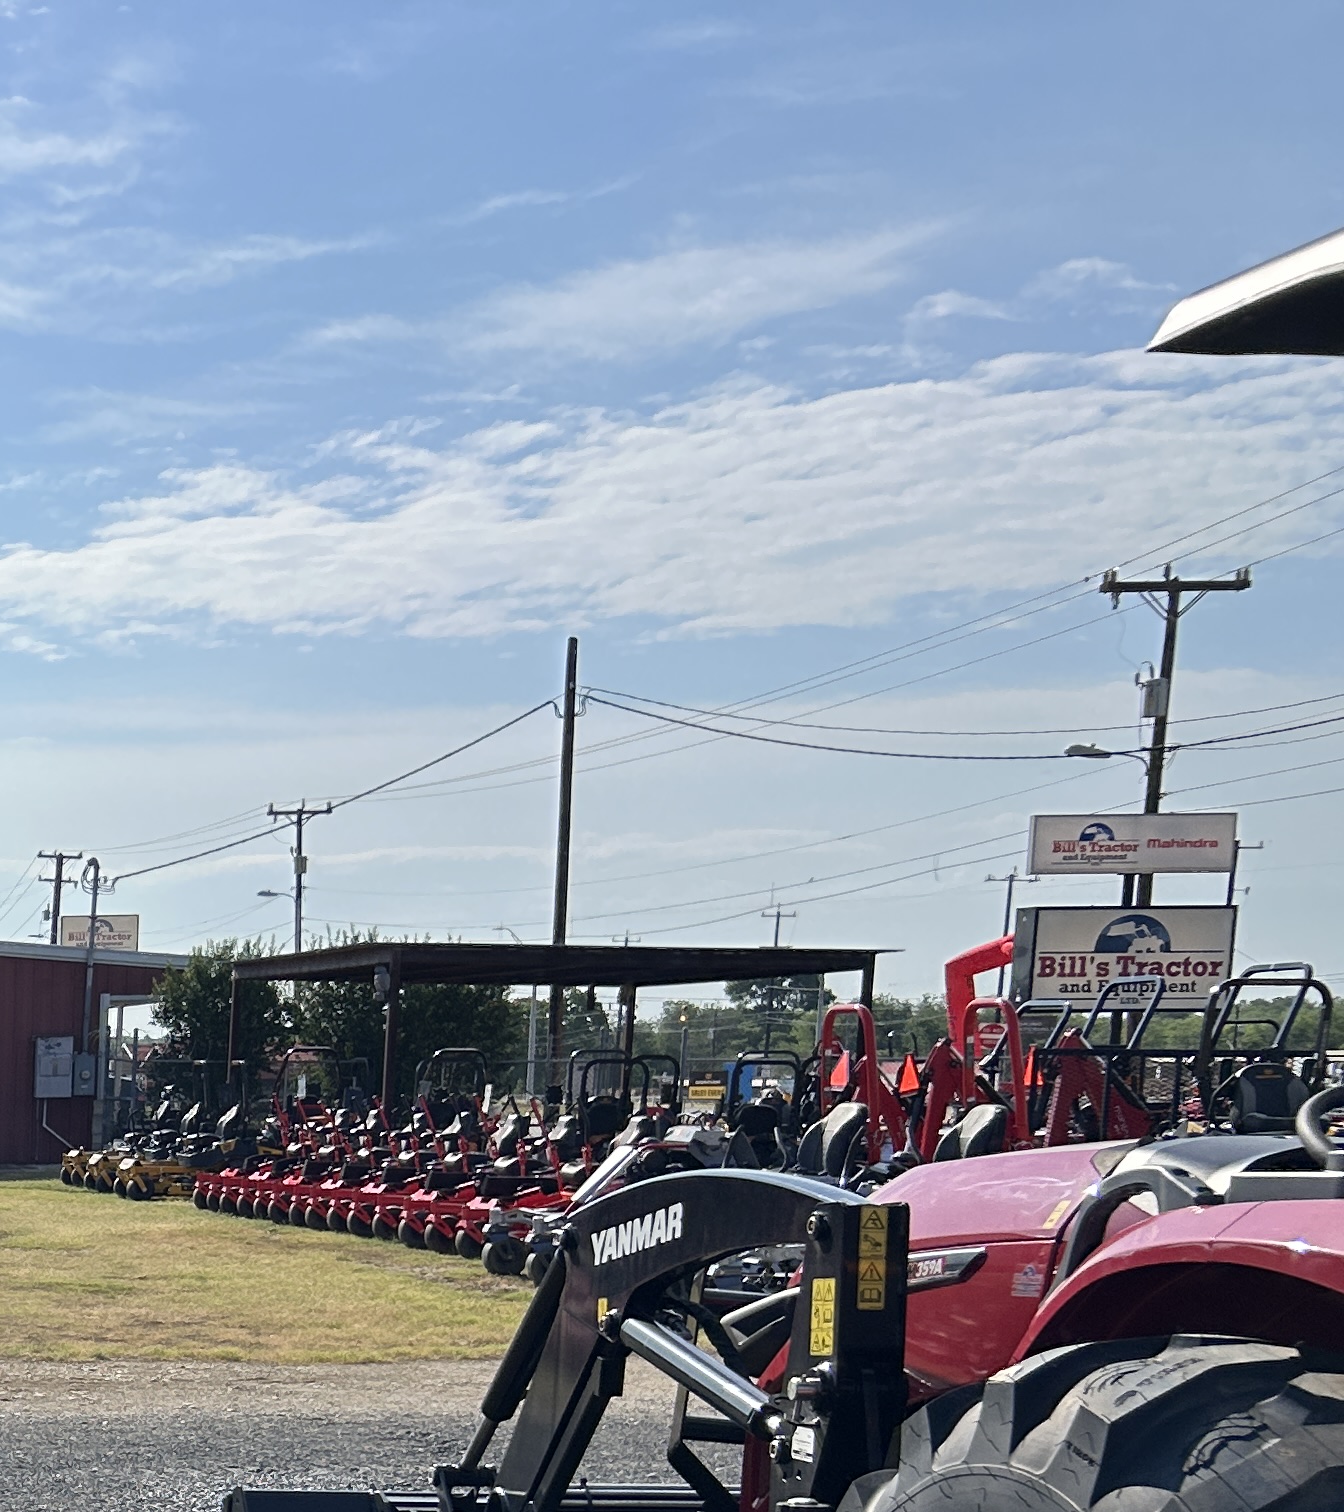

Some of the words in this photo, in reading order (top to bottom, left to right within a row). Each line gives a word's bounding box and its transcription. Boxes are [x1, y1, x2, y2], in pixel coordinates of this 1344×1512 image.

[1052, 840, 1087, 853] Bill's
[1089, 840, 1139, 853] Tractor
[1147, 838, 1219, 849] Mahindra
[96, 931, 132, 940] Tractor
[1037, 956, 1110, 978] Bill's
[1116, 956, 1224, 978] Tractor
[1059, 980, 1092, 994] and
[591, 1202, 683, 1266] YANMAR
